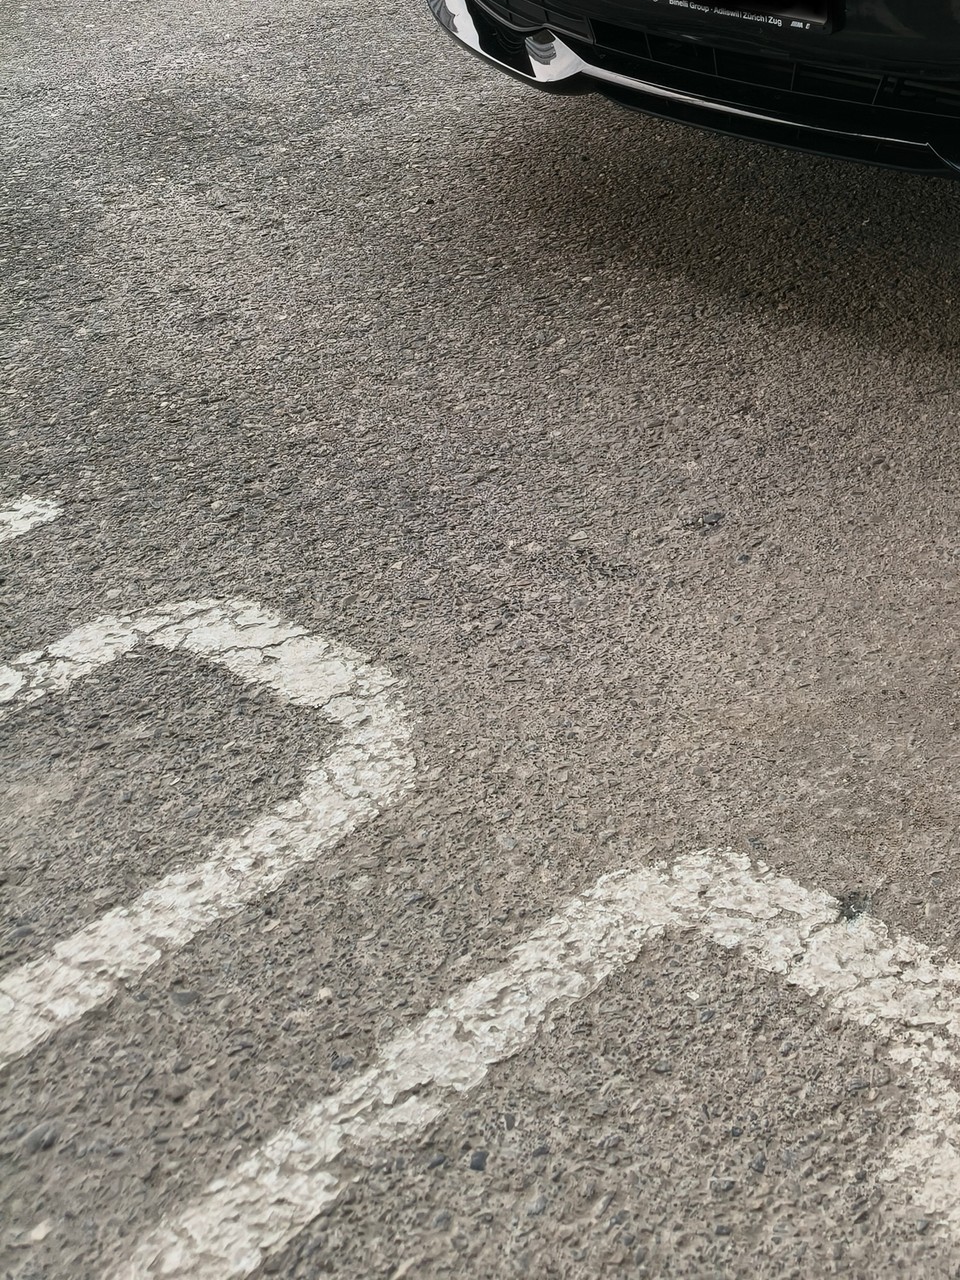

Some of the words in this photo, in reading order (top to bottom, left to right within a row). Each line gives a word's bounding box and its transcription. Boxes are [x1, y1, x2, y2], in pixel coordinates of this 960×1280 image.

[689, 1, 710, 13] Group
[742, 11, 765, 23] Zürich
[768, 15, 783, 27] Zug
